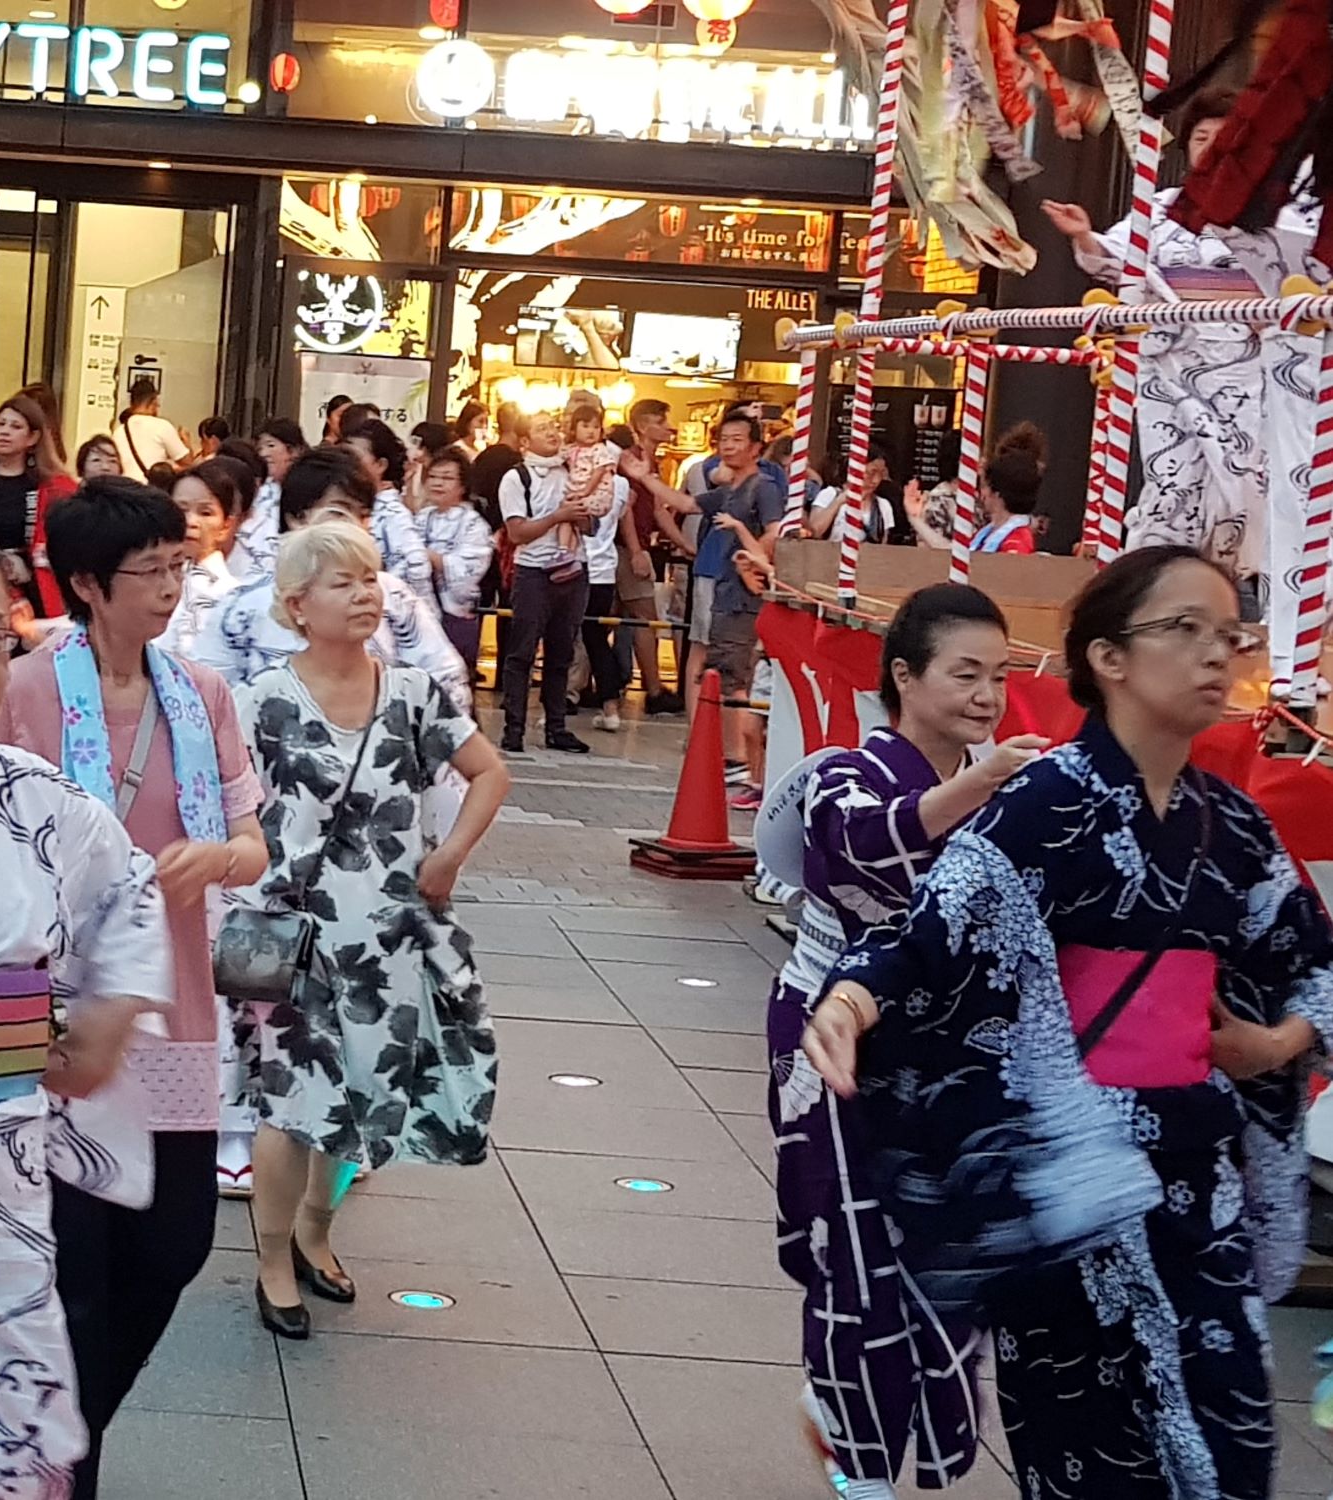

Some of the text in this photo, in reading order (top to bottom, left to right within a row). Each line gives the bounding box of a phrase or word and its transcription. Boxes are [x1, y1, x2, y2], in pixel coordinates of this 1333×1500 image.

[743, 229, 788, 245] time
[747, 289, 817, 311] THE ALLEY
